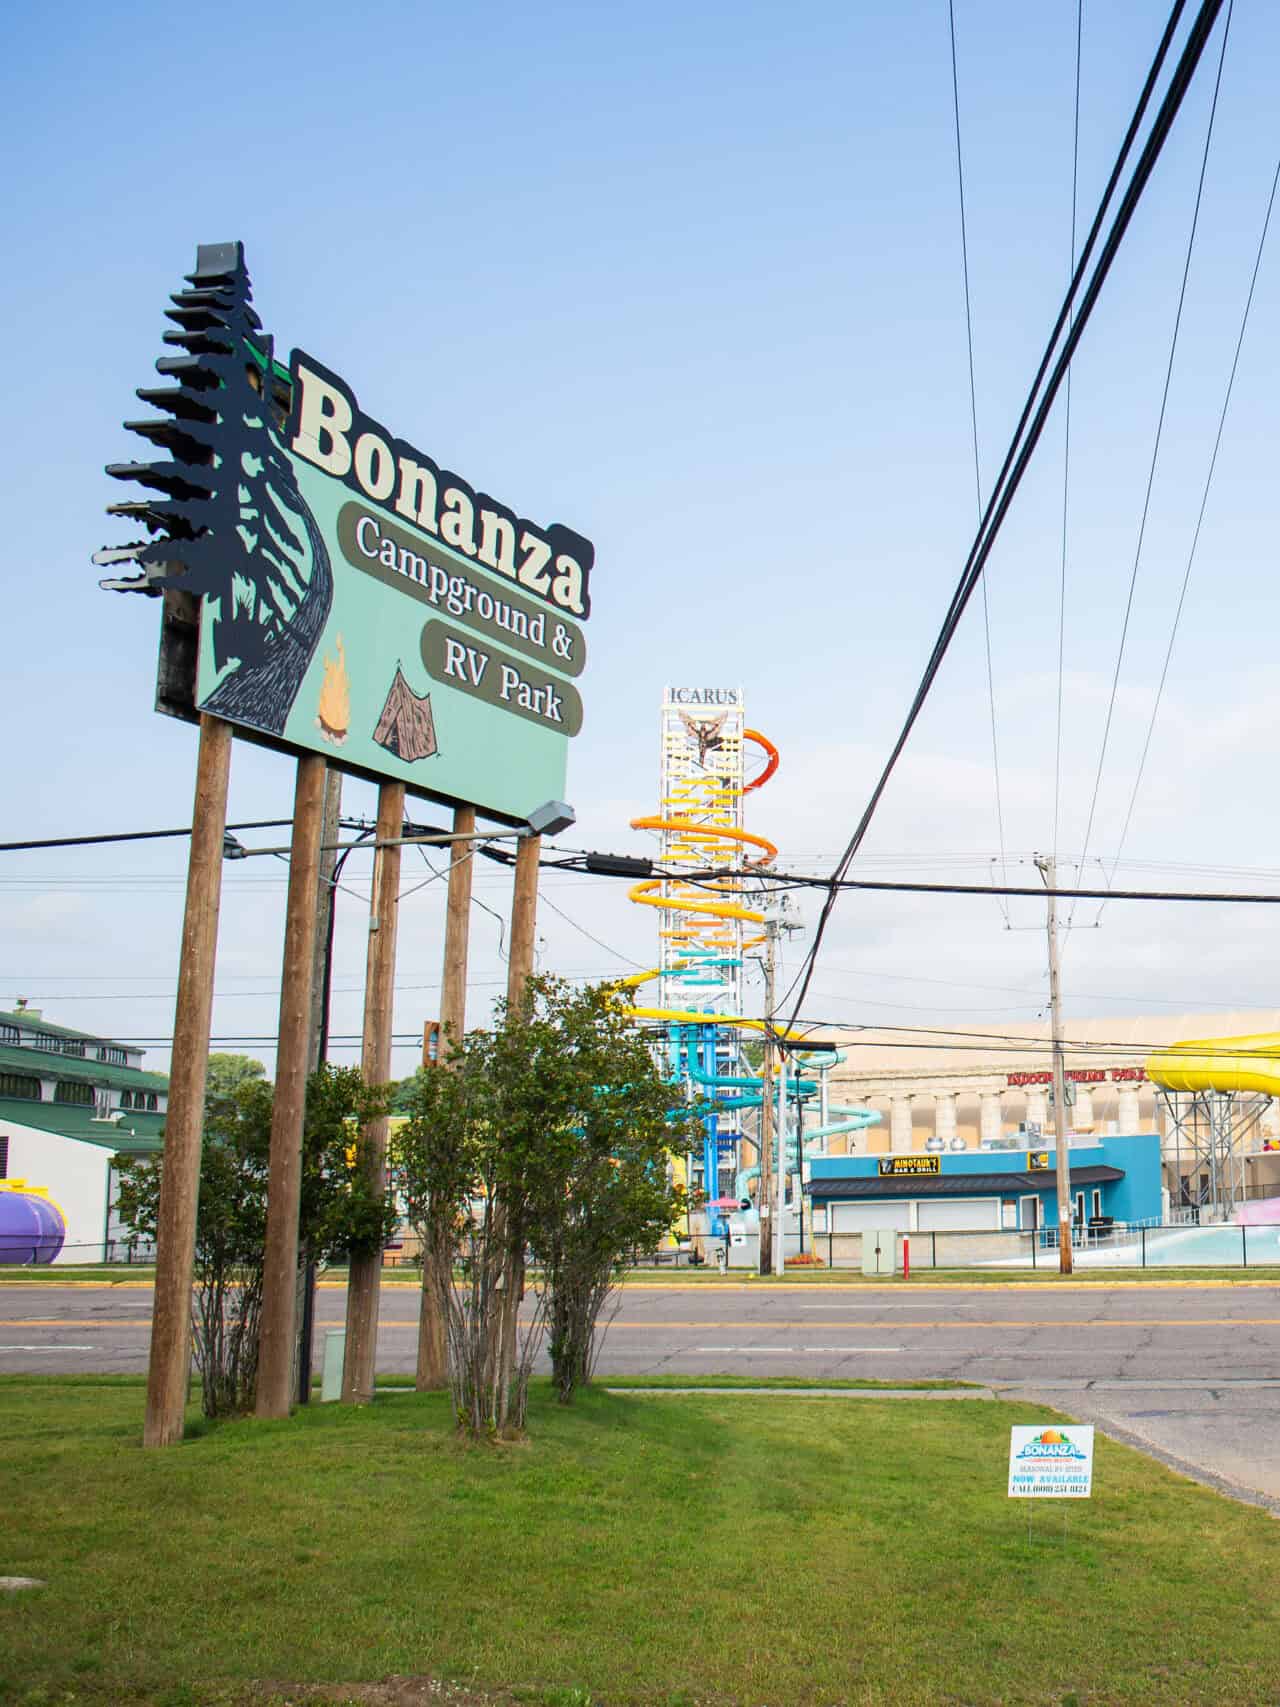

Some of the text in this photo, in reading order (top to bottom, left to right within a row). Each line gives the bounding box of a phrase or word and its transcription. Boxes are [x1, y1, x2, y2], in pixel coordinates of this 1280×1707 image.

[292, 363, 585, 615] Bonanza
[356, 516, 574, 661] Campground &
[443, 637, 563, 723] RV Park
[671, 687, 738, 704] ICARUS
[1023, 1444, 1076, 1457] BONANZA
[1012, 1475, 1034, 1483] NOW
